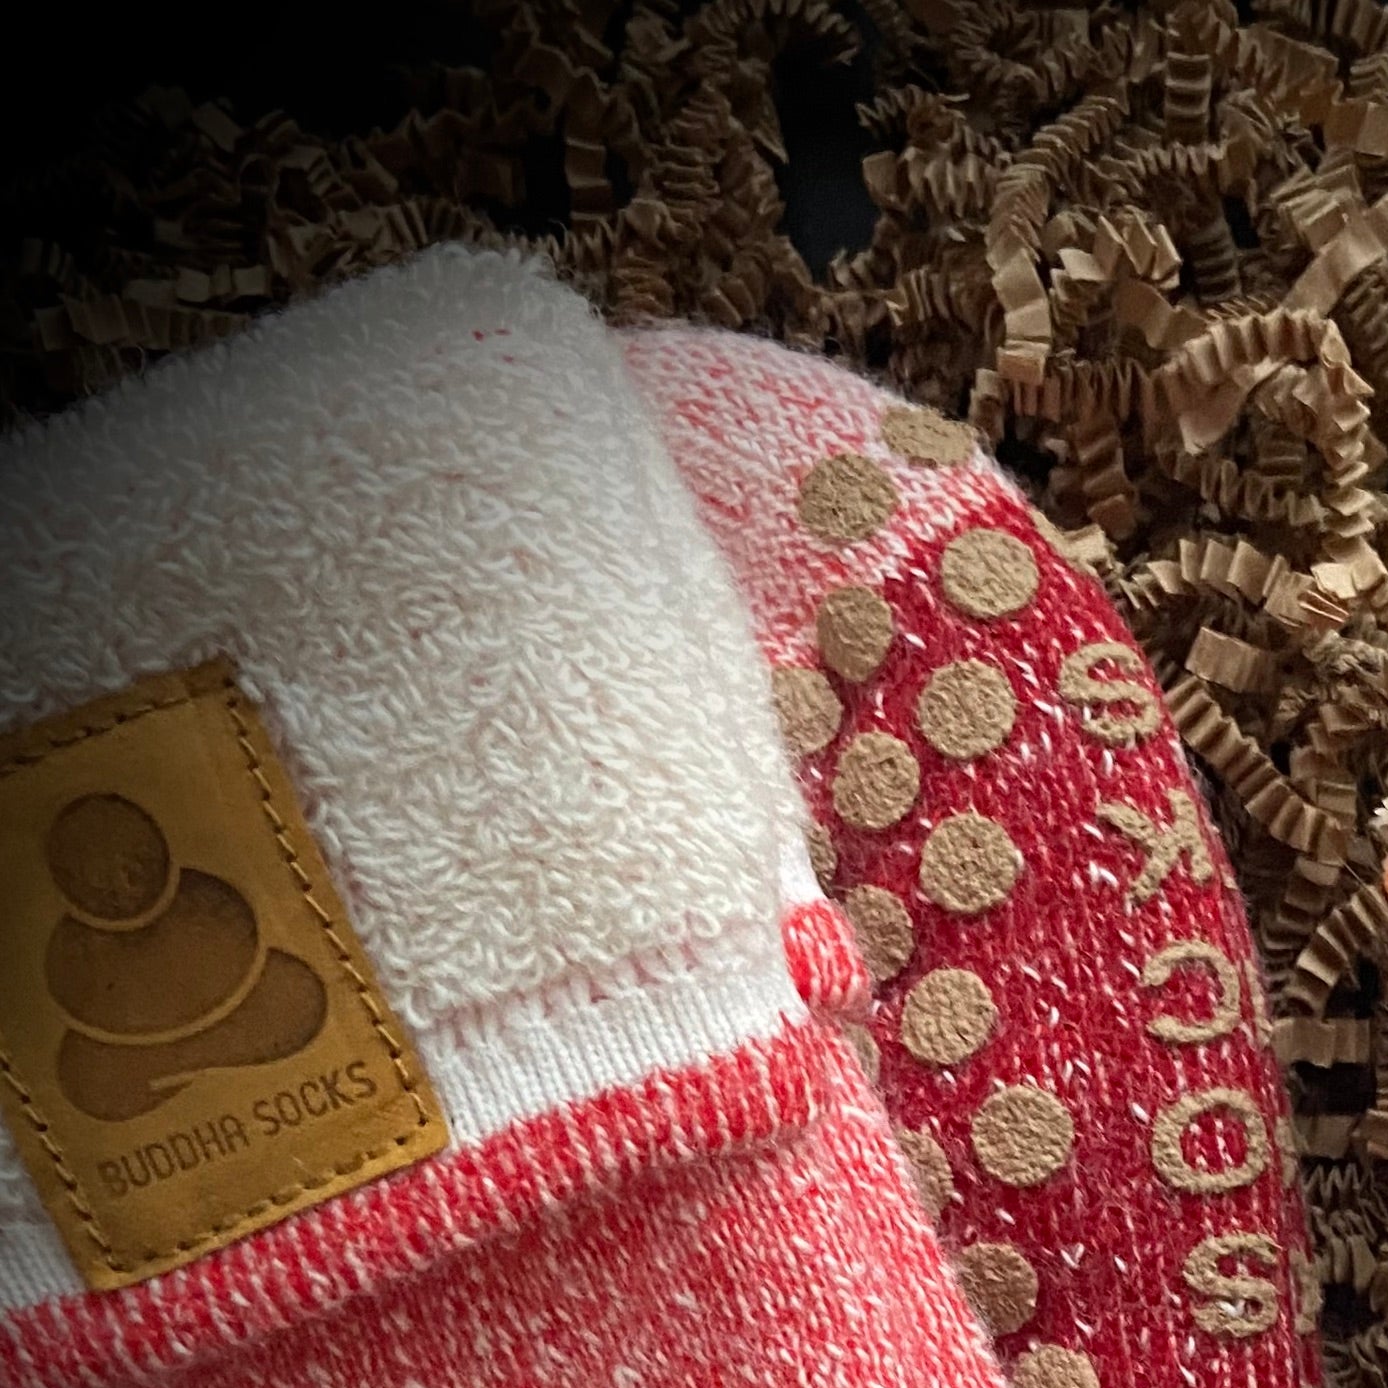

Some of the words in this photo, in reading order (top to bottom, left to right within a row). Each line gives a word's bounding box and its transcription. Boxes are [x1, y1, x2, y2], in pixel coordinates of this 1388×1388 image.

[97, 1114, 250, 1198] BUDDHA
[252, 1060, 378, 1136] SOCKS
[1058, 640, 1281, 1339] SOCKS
